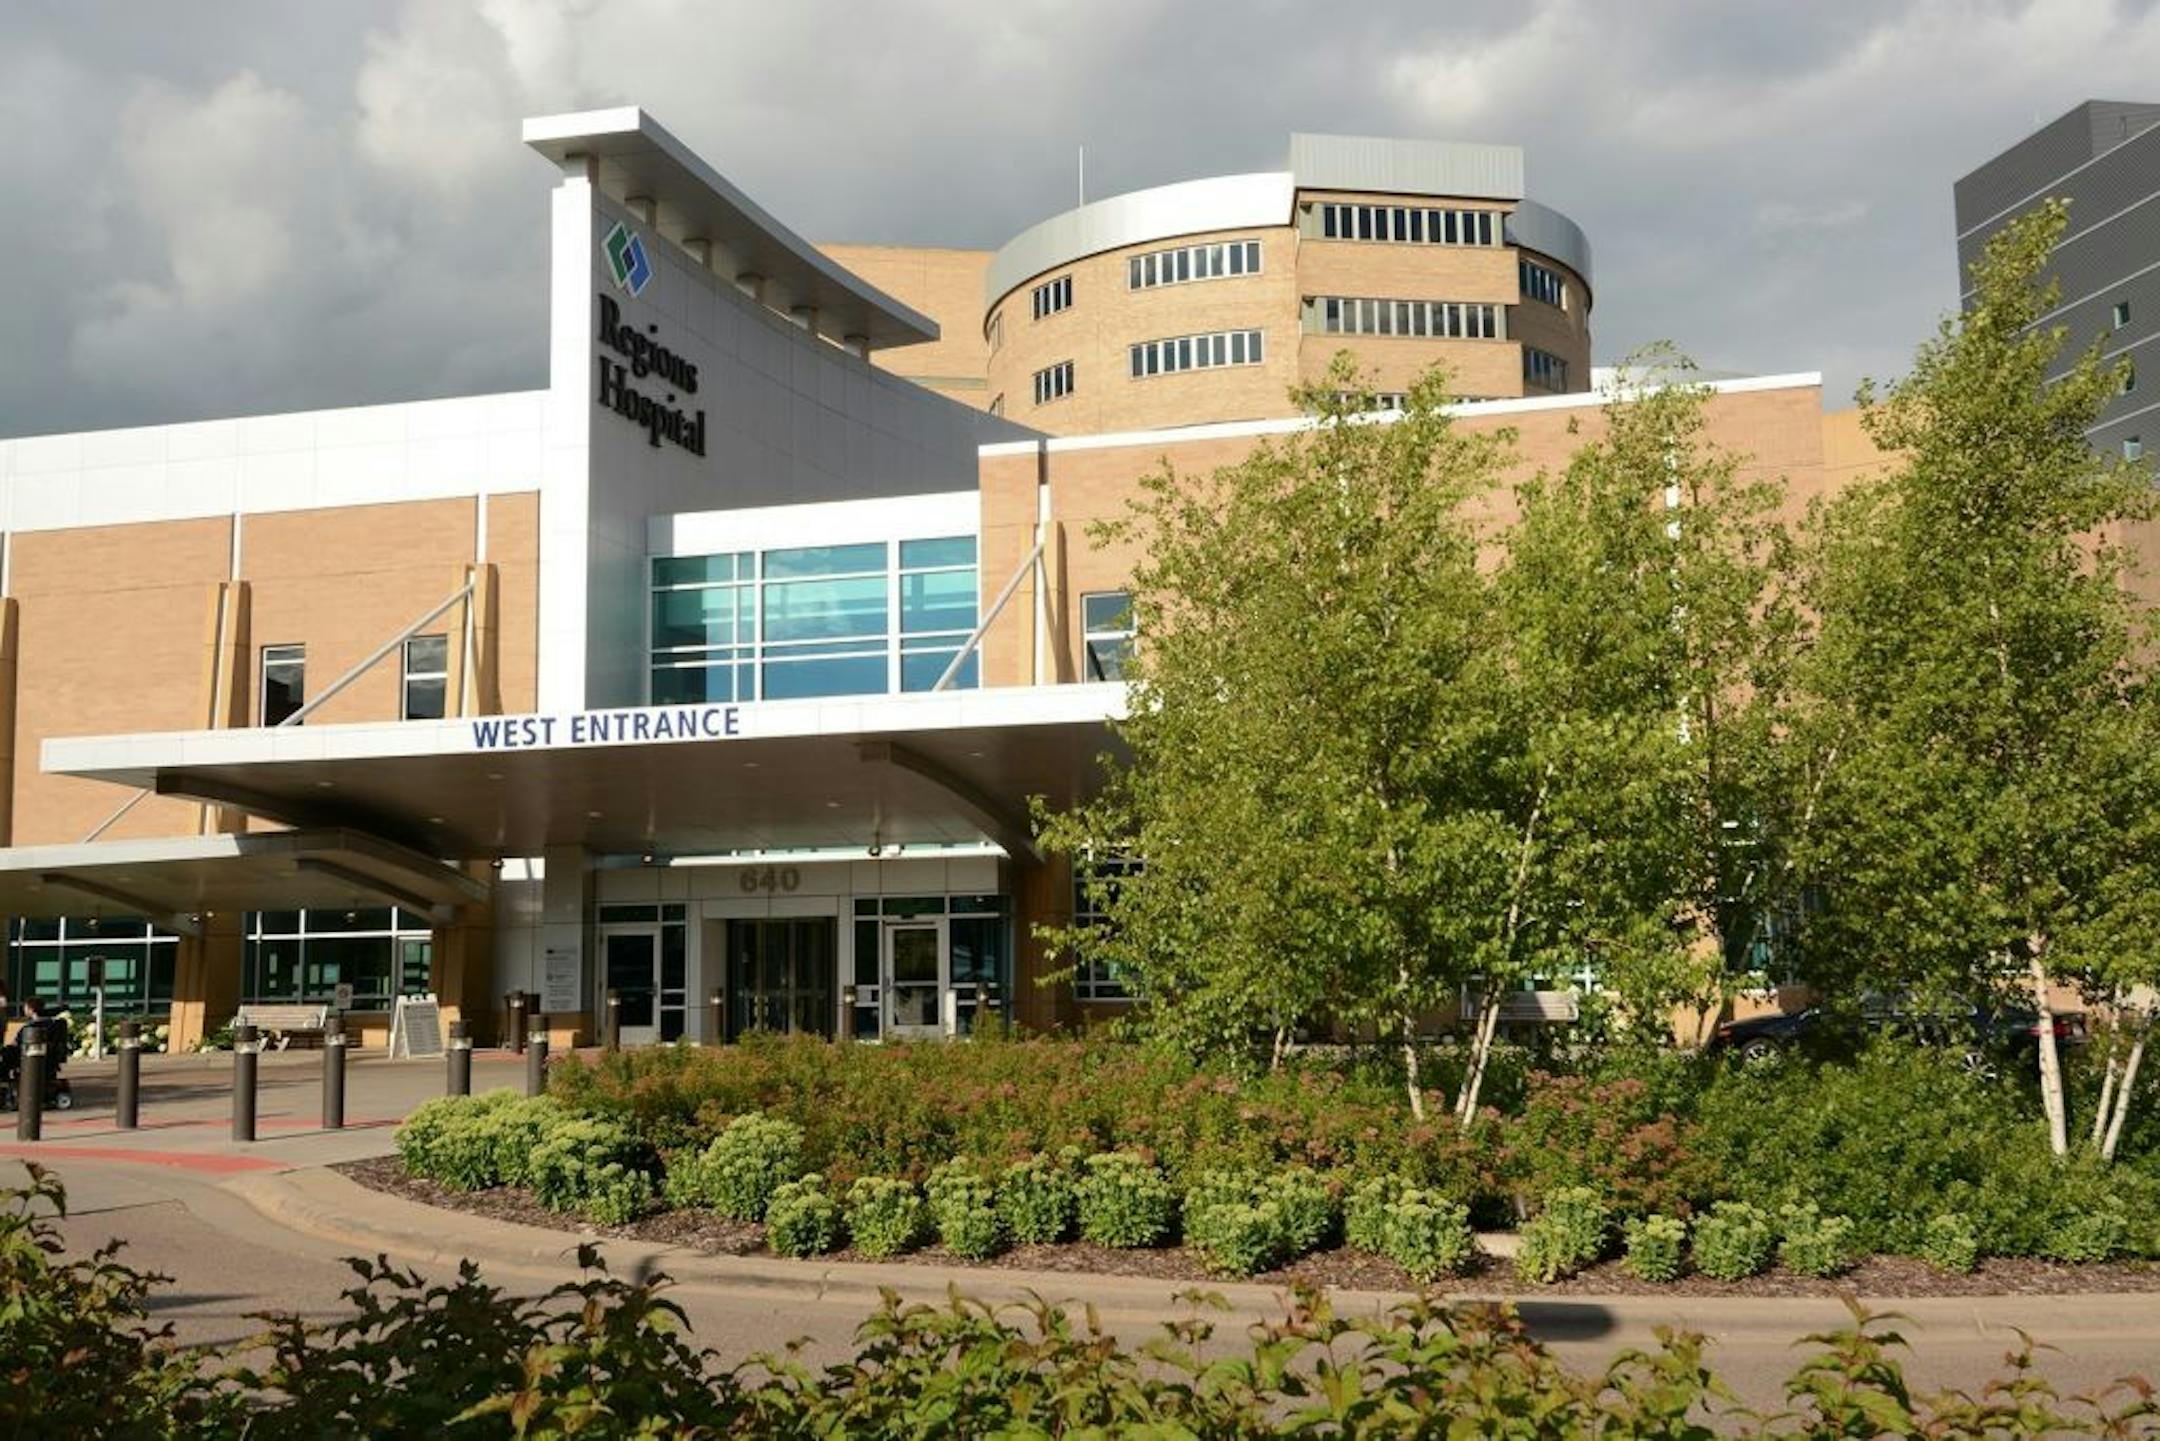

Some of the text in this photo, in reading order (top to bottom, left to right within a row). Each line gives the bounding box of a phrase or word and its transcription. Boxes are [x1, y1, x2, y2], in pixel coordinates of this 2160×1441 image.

[598, 293, 698, 394] Regions
[598, 355, 706, 457] Hospital
[473, 707, 739, 748] WEST ENTRANCE
[740, 866, 800, 893] 640
